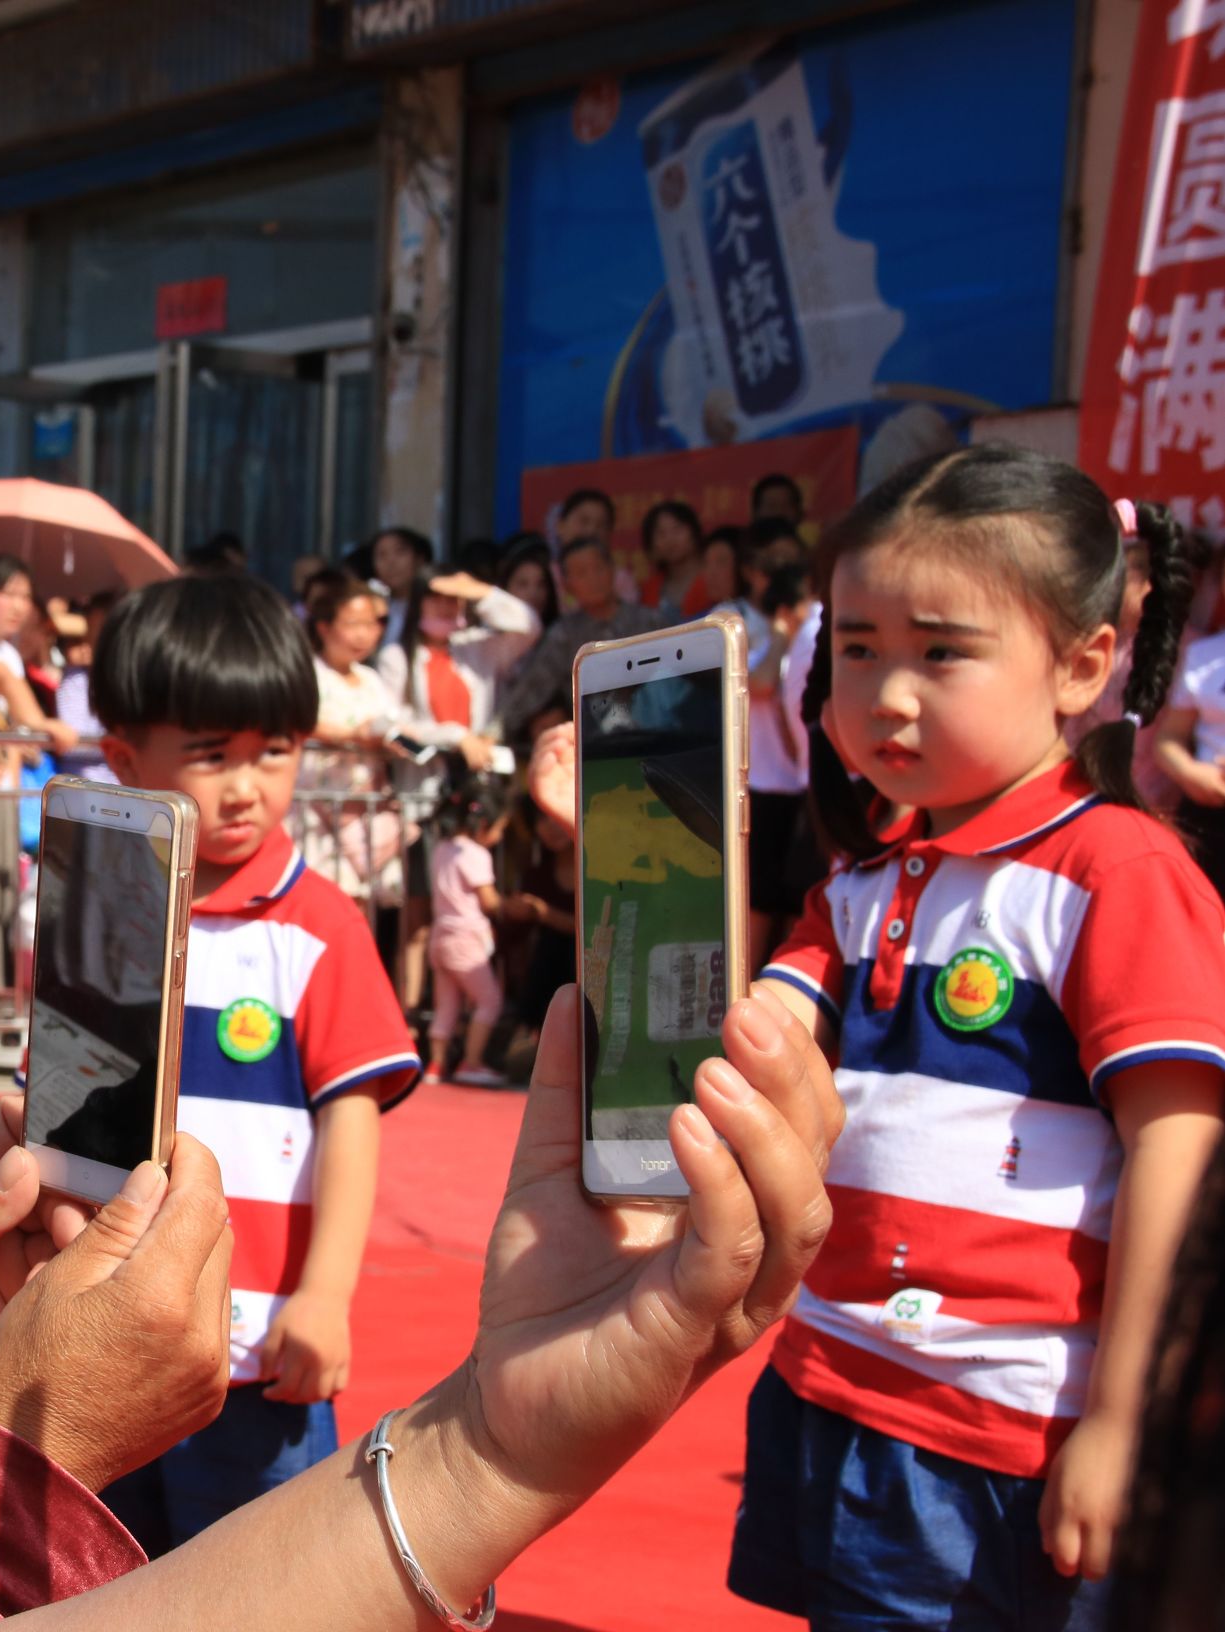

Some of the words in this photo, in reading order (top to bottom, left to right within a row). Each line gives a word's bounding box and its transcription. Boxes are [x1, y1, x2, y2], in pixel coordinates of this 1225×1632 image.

[703, 153, 791, 387] 六个核桃
[640, 1155, 672, 1171] honor
